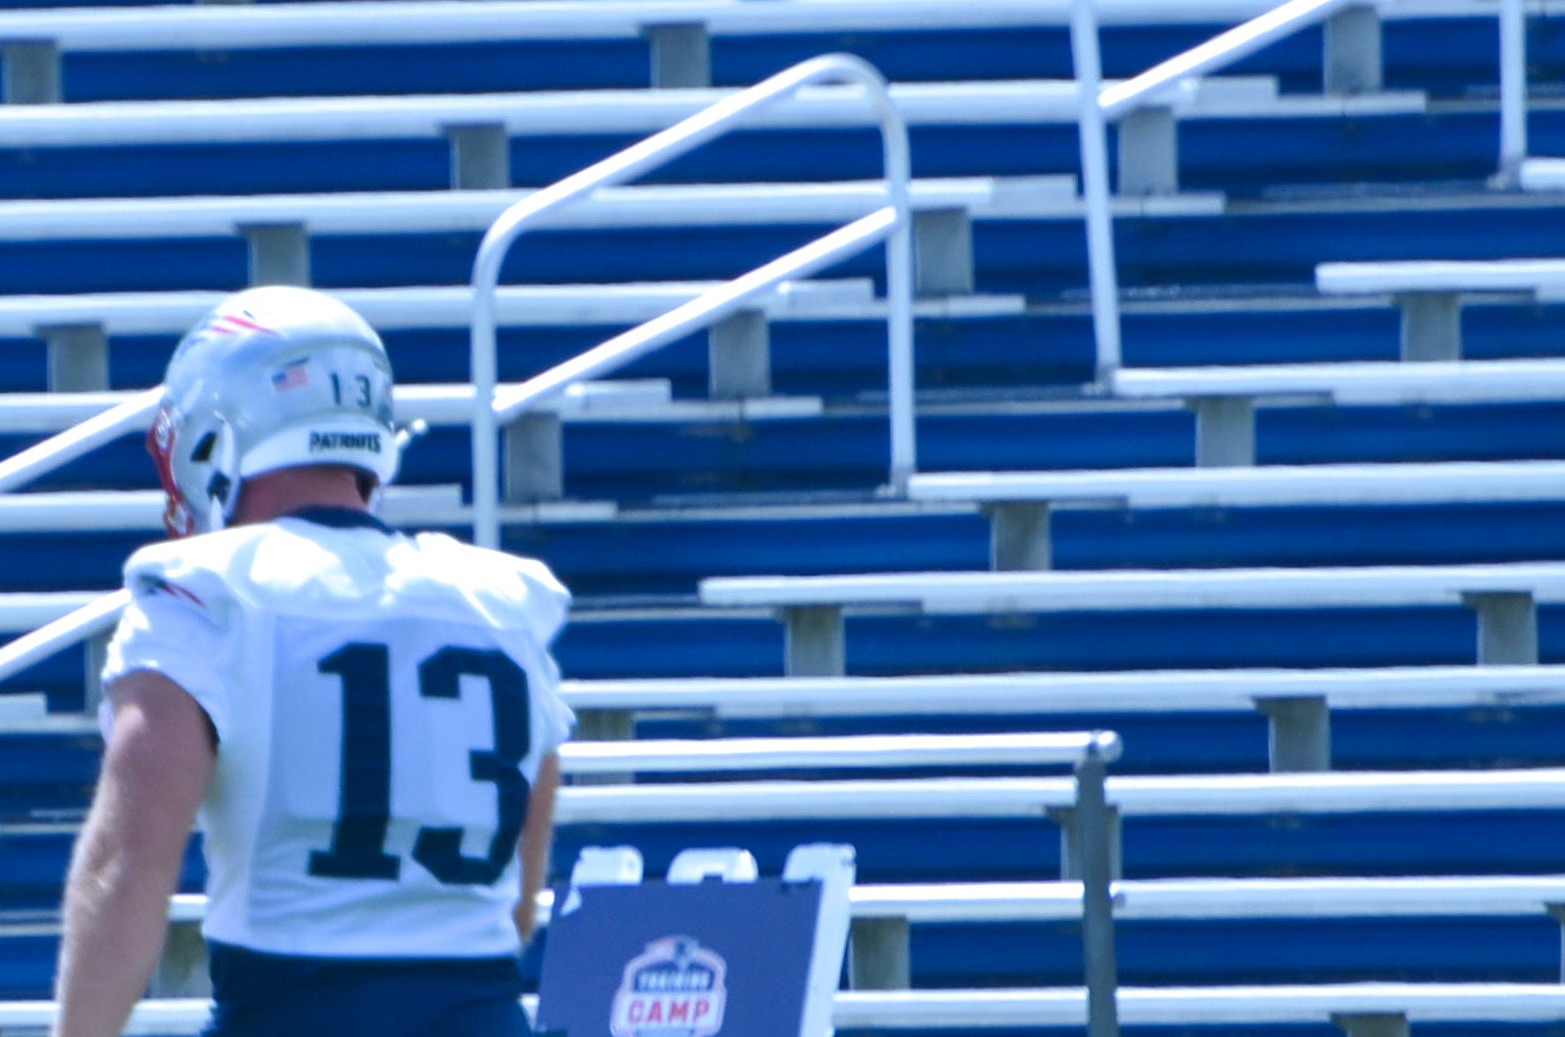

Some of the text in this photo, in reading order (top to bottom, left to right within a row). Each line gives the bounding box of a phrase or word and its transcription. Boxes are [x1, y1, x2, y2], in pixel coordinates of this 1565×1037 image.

[330, 372, 371, 408] 13
[309, 431, 381, 454] PATRIOTS
[307, 642, 531, 886] 13
[628, 999, 711, 1024] CAMP
